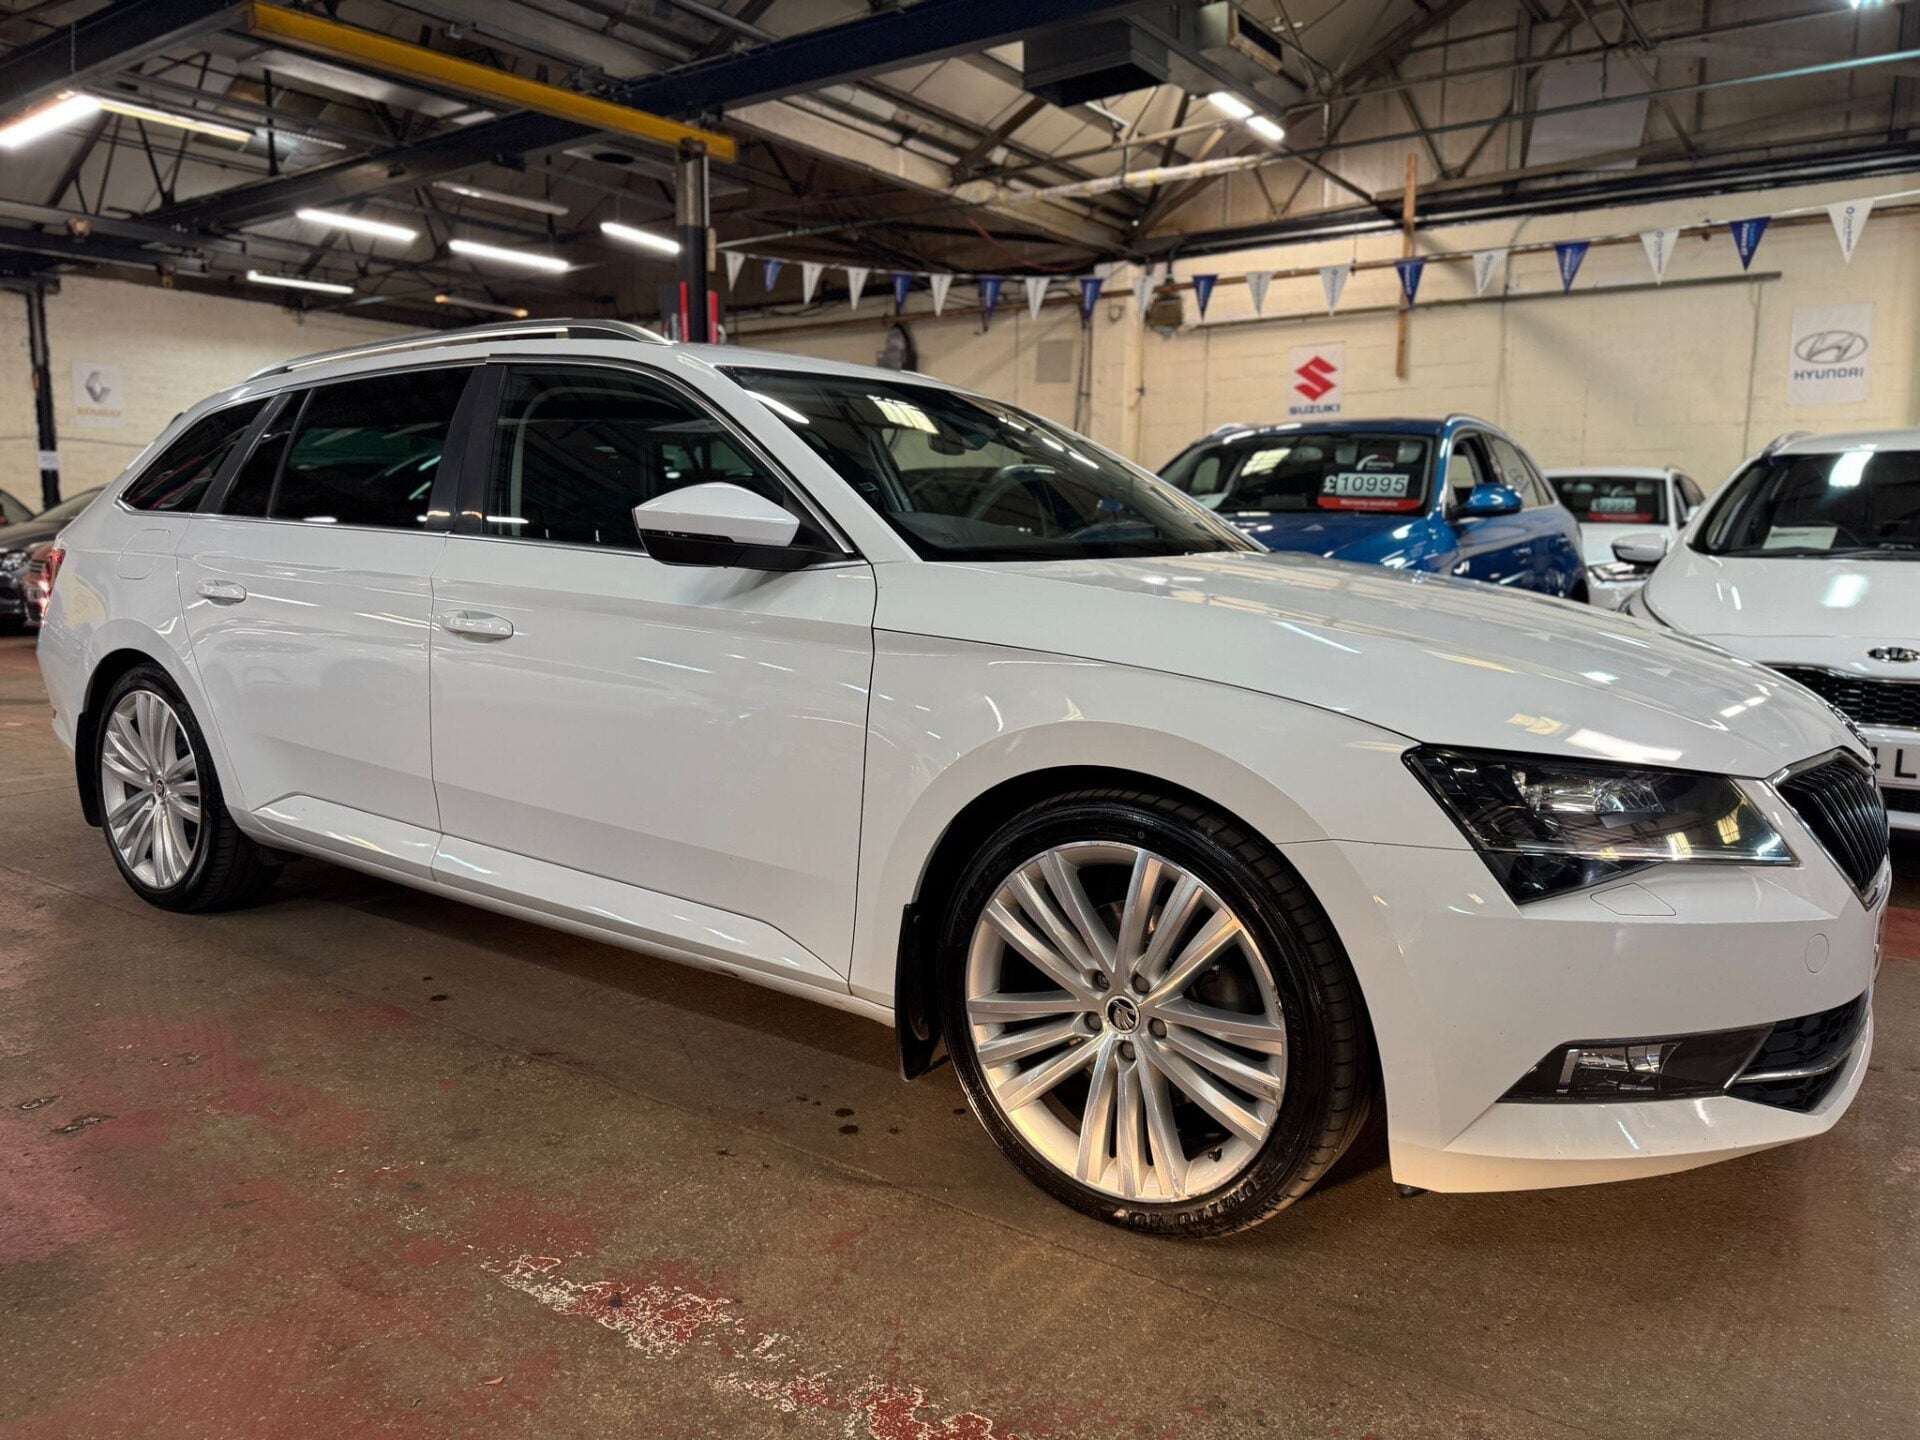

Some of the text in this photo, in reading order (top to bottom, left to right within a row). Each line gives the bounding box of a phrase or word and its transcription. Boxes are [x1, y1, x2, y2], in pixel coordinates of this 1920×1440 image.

[1793, 367, 1864, 380] HYUNDAI
[1289, 403, 1341, 416] SUZUKI
[1323, 475, 1406, 493] £10995
